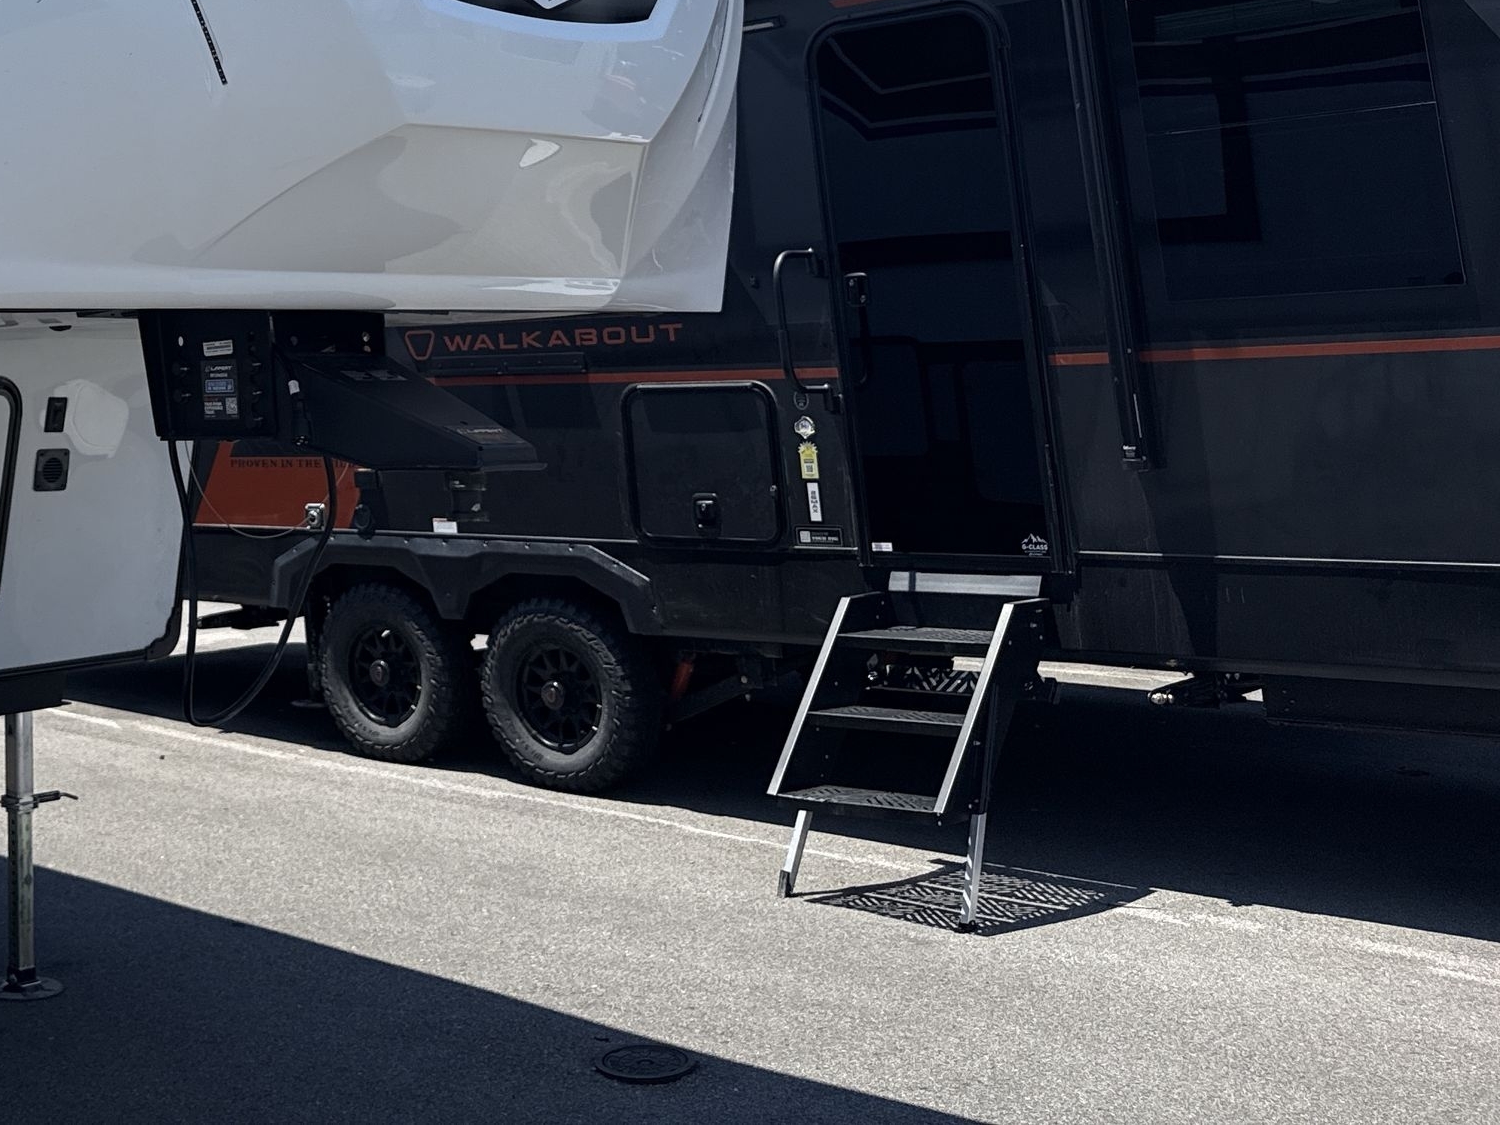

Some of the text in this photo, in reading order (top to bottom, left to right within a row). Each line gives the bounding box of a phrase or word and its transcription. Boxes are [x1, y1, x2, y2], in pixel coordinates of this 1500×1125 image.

[443, 323, 684, 352] WALKABOUT
[230, 458, 278, 469] PROVEN
[280, 458, 293, 469] IN
[296, 458, 322, 469] THE
